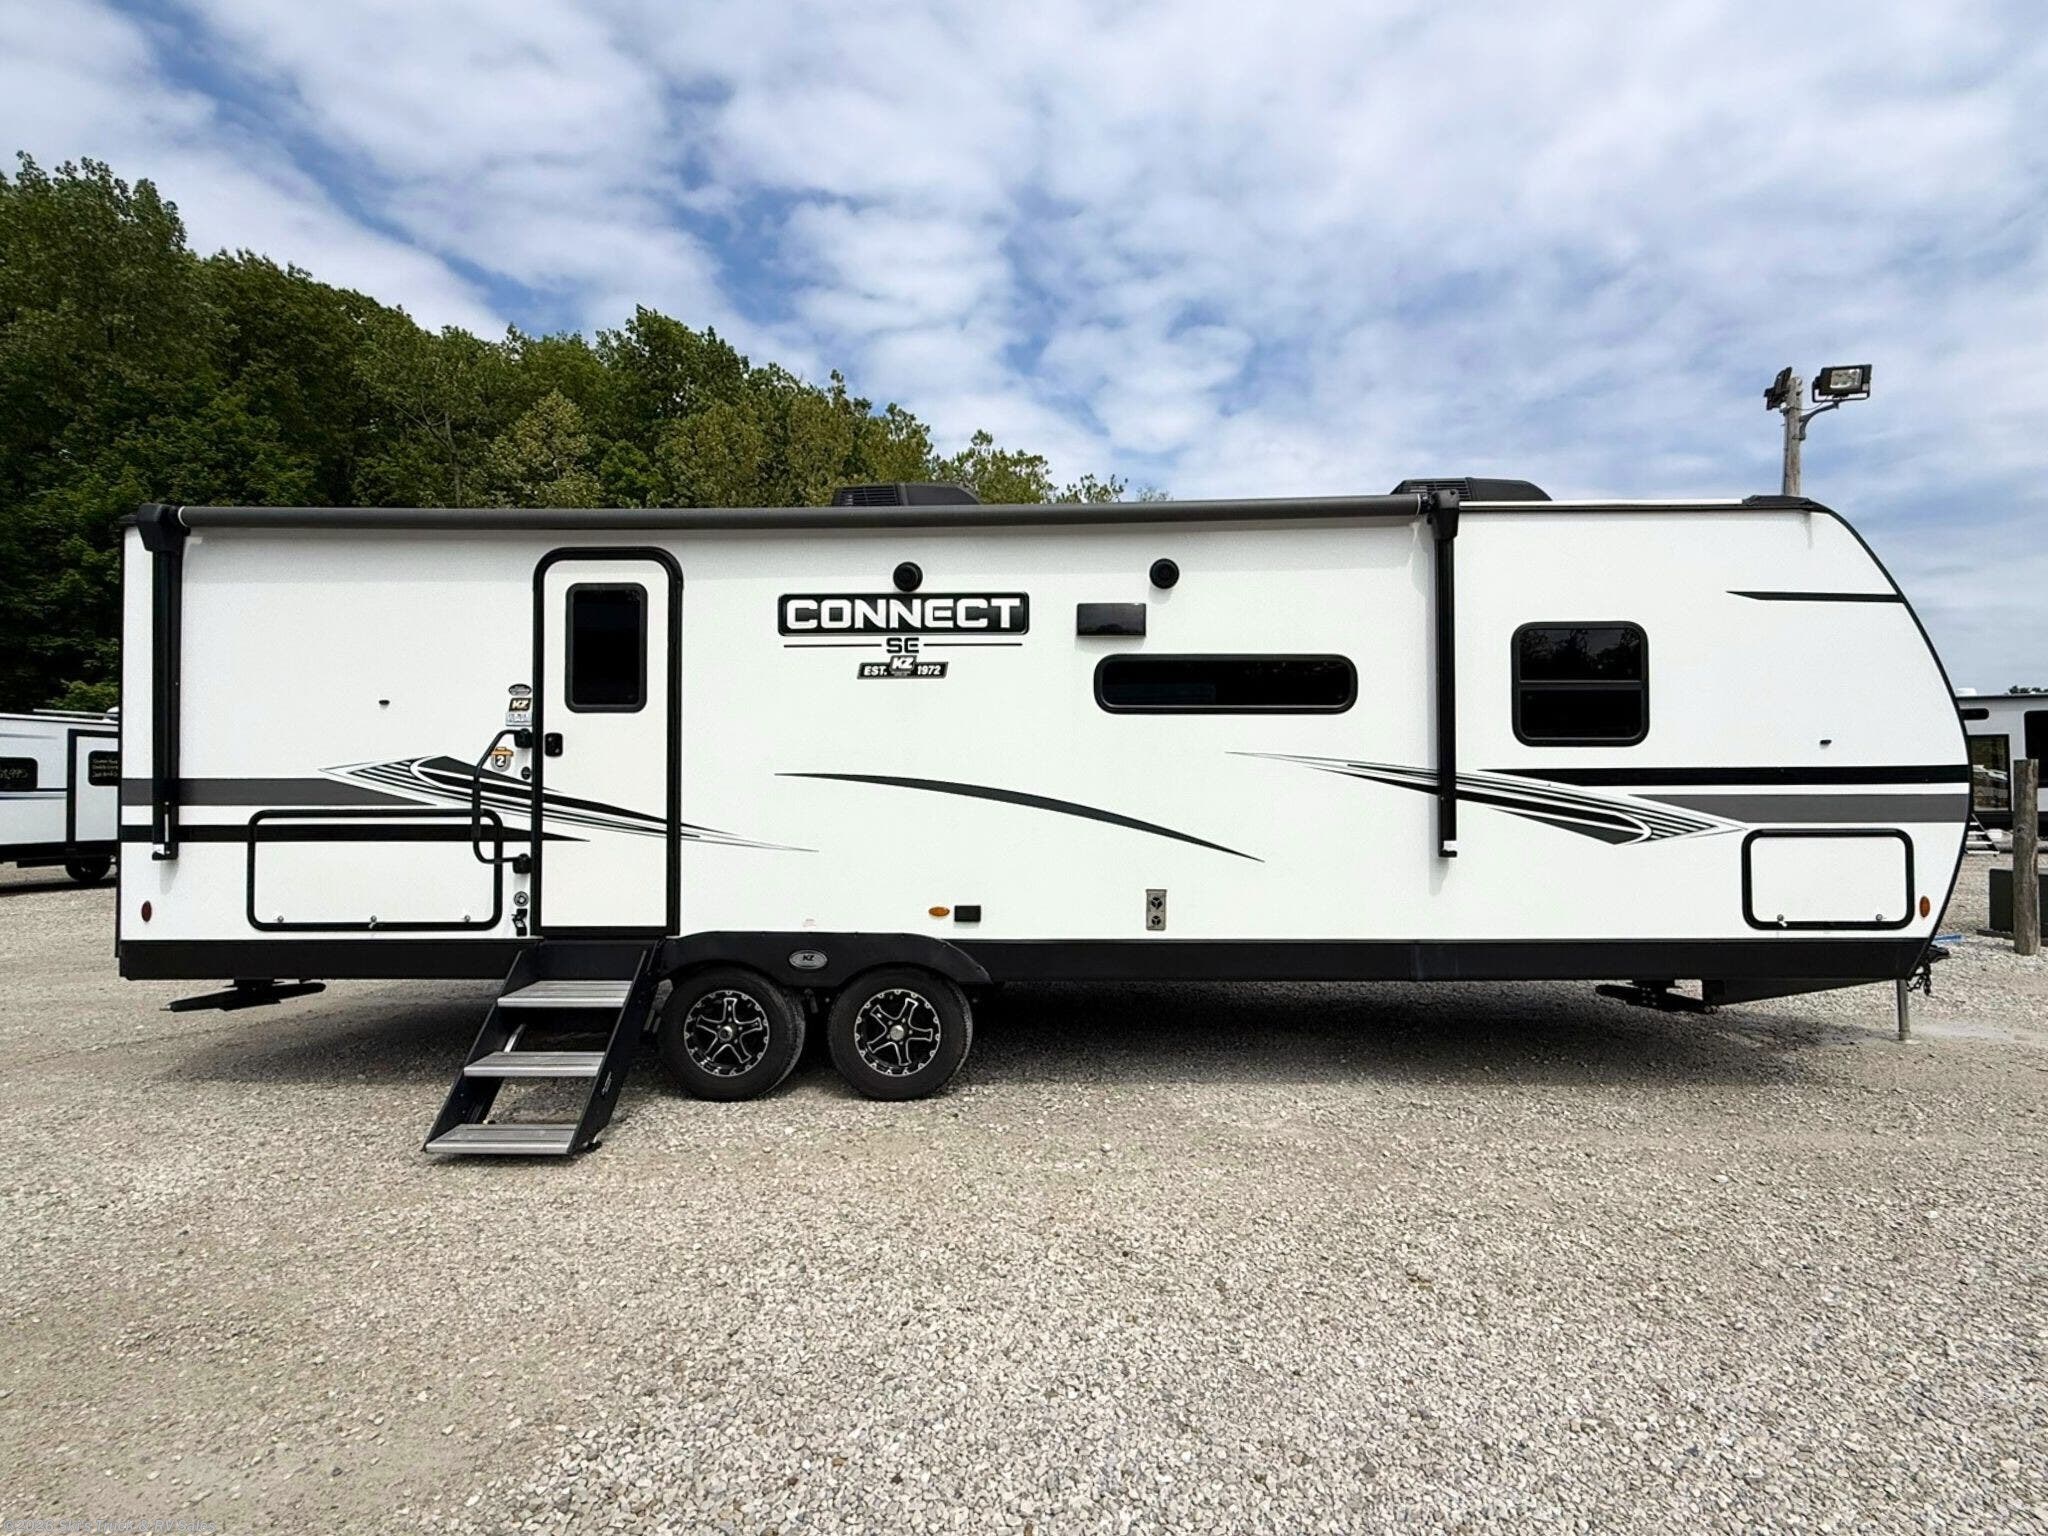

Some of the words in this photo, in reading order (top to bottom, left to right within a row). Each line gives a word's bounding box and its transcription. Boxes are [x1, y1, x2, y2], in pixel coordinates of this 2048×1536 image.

[786, 598, 1021, 630] CONNECT
[886, 637, 920, 653] SE
[892, 657, 914, 669] KZ
[863, 665, 888, 676] EST.
[917, 665, 941, 675] 1972
[511, 700, 529, 710] KZ
[496, 756, 505, 765] 2
